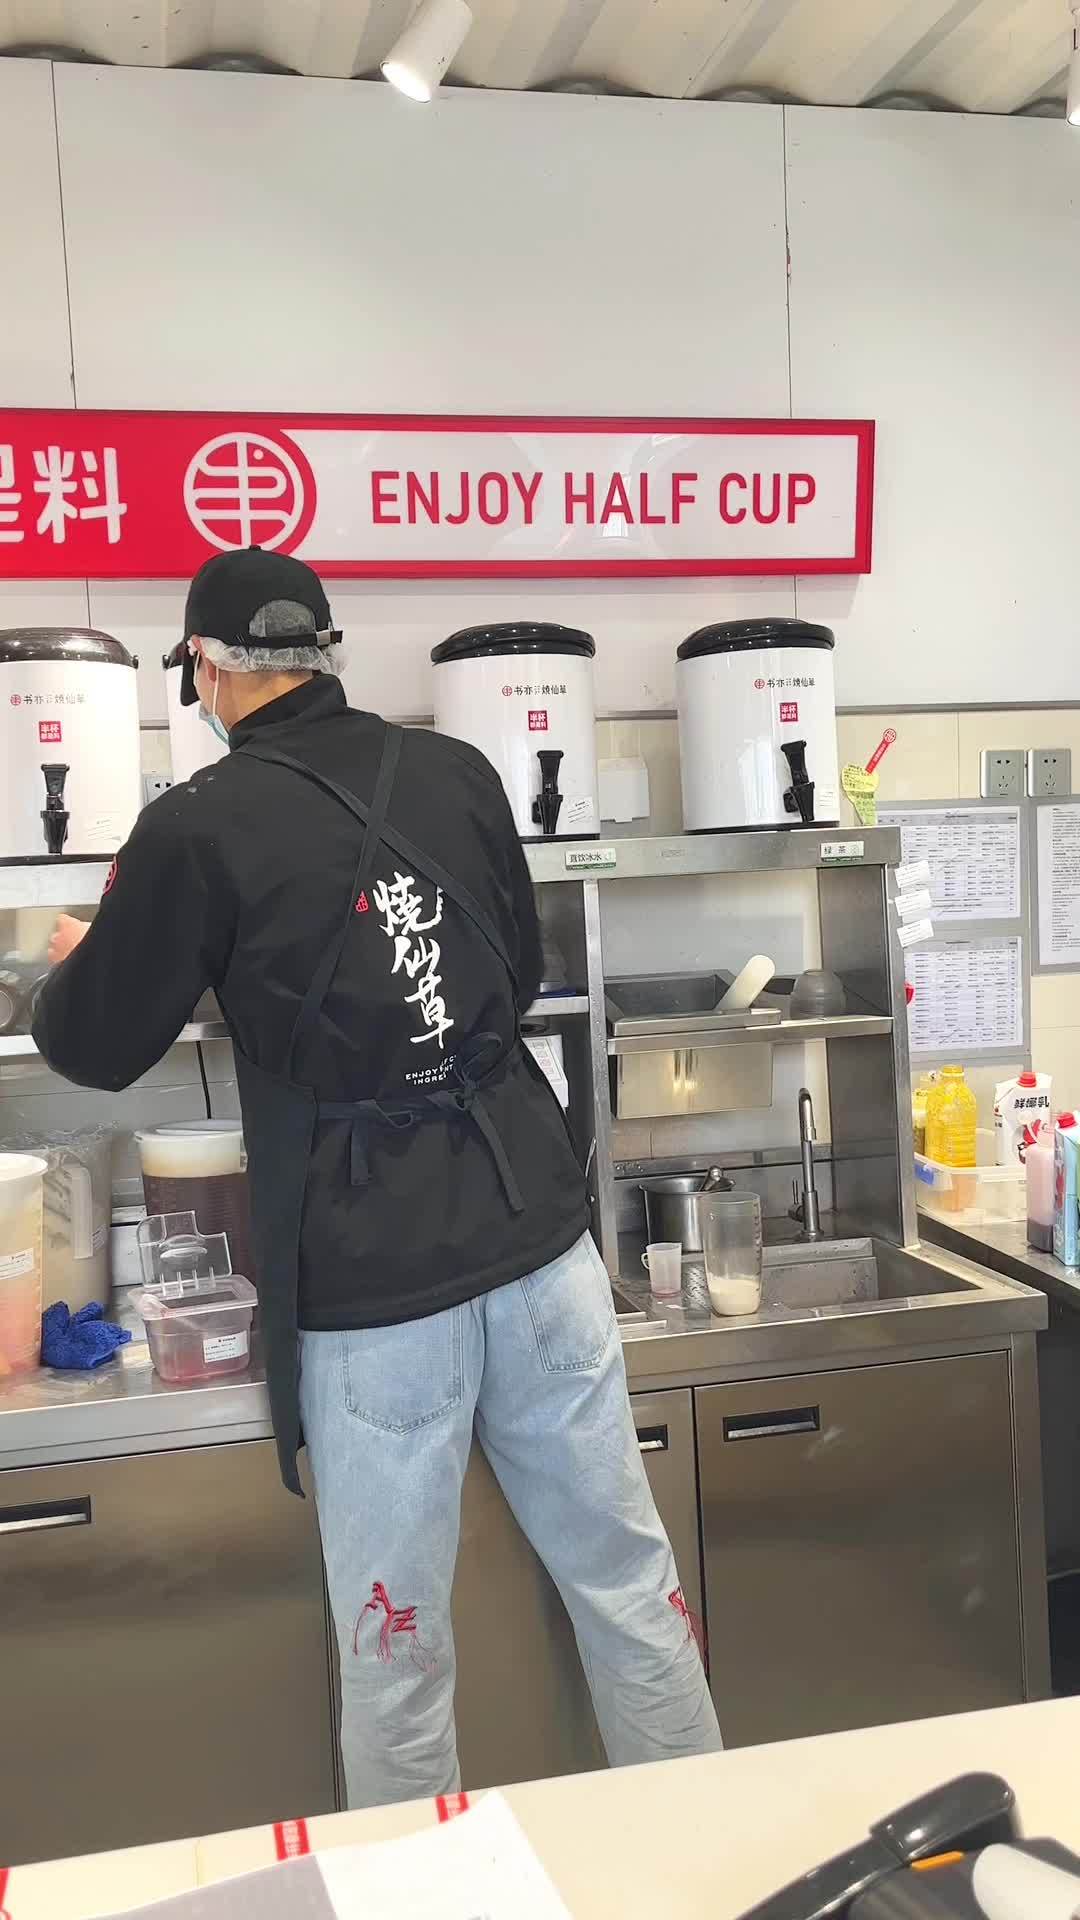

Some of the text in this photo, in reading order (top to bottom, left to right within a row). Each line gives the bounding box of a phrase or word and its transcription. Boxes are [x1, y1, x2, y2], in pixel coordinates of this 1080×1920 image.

[0, 444, 128, 544] 料
[371, 470, 816, 525] ENJOY HALF CUP
[405, 1068, 438, 1080] ENJOY
